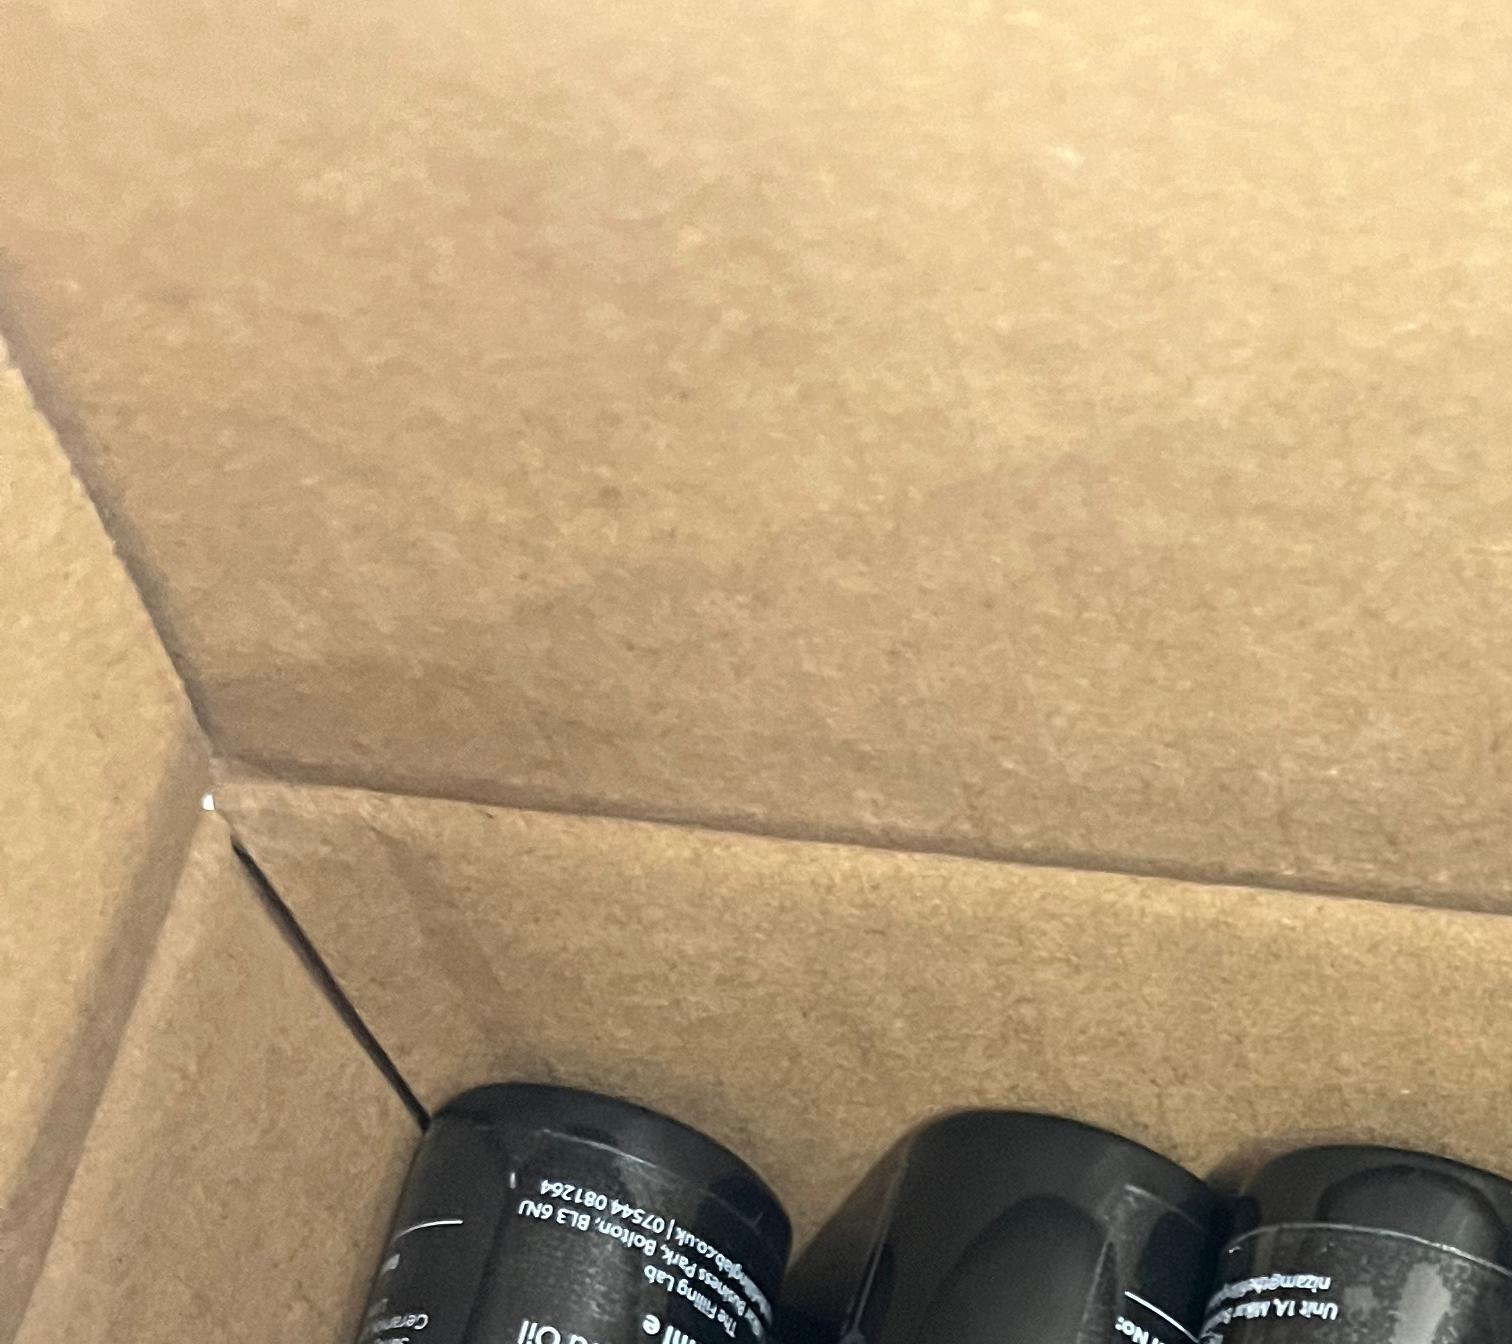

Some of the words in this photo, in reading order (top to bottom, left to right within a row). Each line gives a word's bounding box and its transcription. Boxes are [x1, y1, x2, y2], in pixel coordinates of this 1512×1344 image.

[518, 1199, 553, 1220] 6NJ
[540, 1179, 607, 1210] 081264
[557, 1207, 590, 1230] BL3
[611, 1198, 665, 1233] 07544
[595, 1217, 656, 1256] Bolton,
[660, 1244, 696, 1278] Park,
[644, 1264, 674, 1291] Lab
[676, 1279, 717, 1319] Filling
[717, 1309, 737, 1338] The
